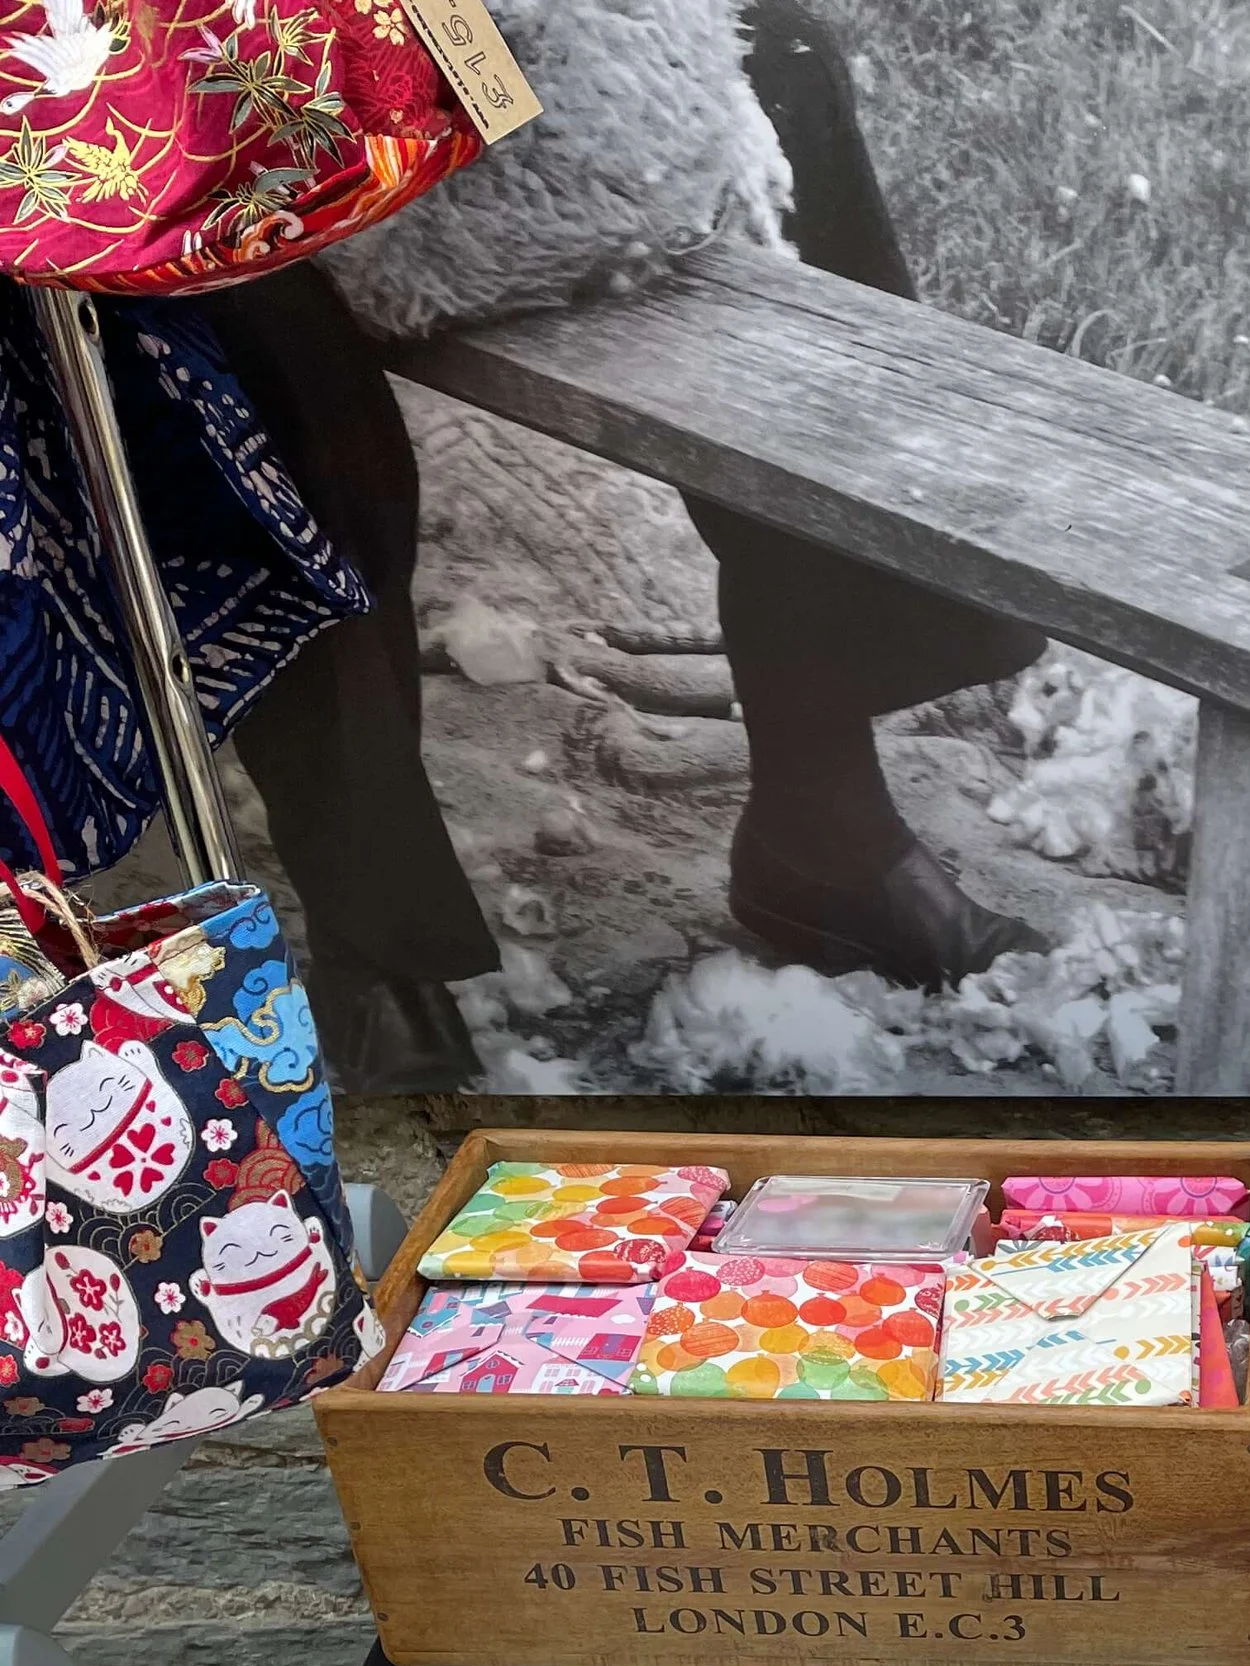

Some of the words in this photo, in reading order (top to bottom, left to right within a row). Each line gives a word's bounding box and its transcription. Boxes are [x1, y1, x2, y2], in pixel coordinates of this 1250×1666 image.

[482, 1441, 590, 1502] C.
[619, 1444, 724, 1505] T.
[752, 1447, 1135, 1515] HOLMES
[561, 1517, 686, 1550] FISH
[718, 1521, 1073, 1559] MERCHANTS
[524, 1561, 576, 1592] 40
[601, 1564, 723, 1594] FISH
[751, 1568, 961, 1601] STREET
[982, 1573, 1120, 1602] HILL
[634, 1607, 868, 1639] LONDON
[899, 1612, 1026, 1642] E.C.3
